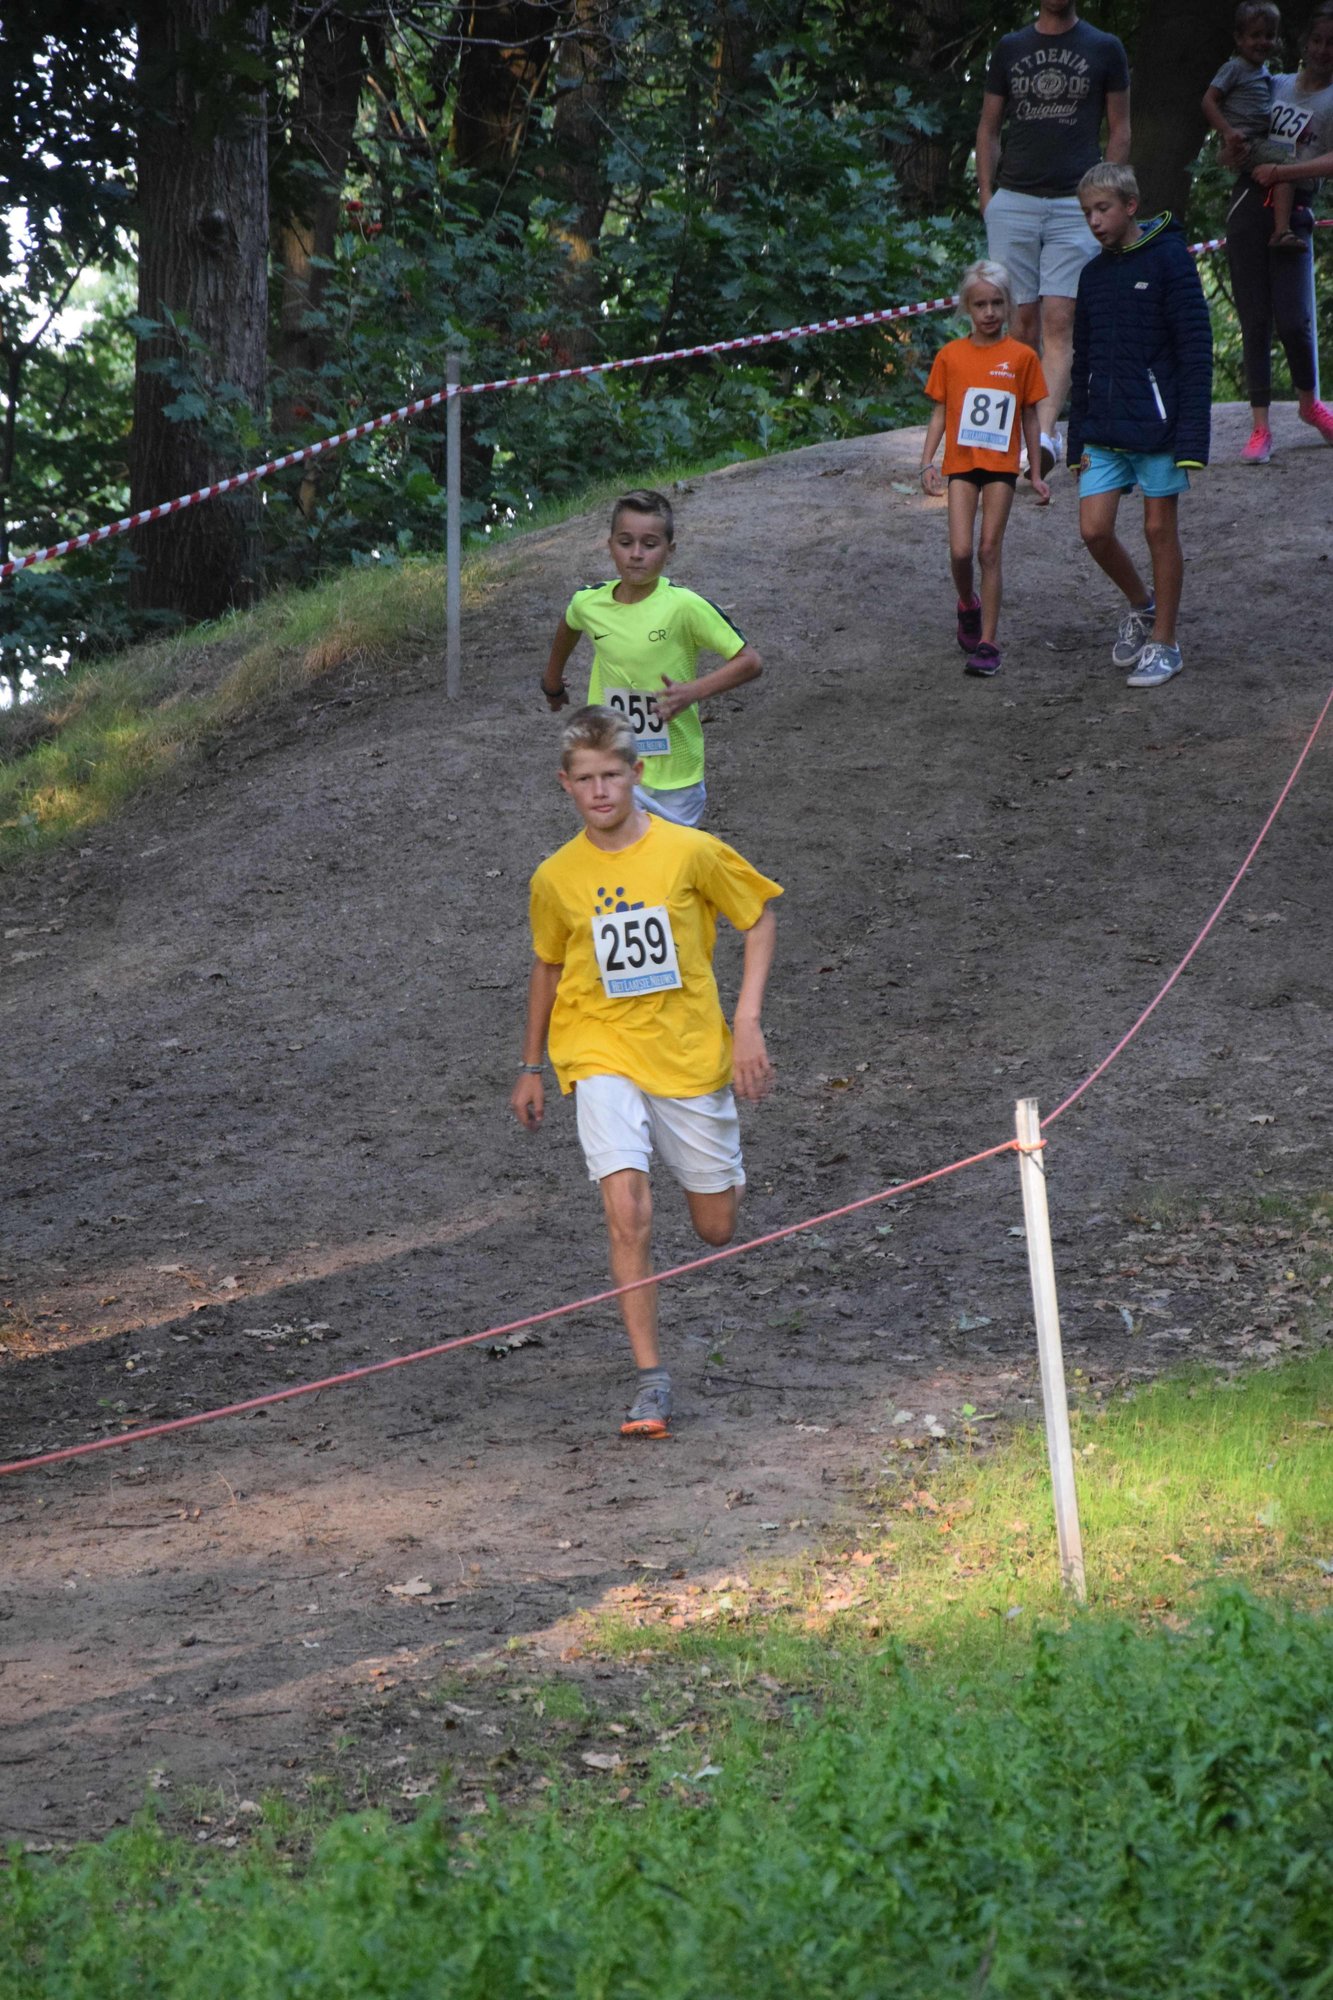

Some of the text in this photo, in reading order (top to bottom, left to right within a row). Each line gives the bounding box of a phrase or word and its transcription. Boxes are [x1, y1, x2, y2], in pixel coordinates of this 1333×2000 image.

[1035, 48, 1090, 75] DENIM
[1011, 76, 1030, 94] 20
[1016, 100, 1077, 120] Original
[1270, 105, 1308, 138] 225
[970, 393, 1010, 430] 81
[601, 916, 668, 971] 259
